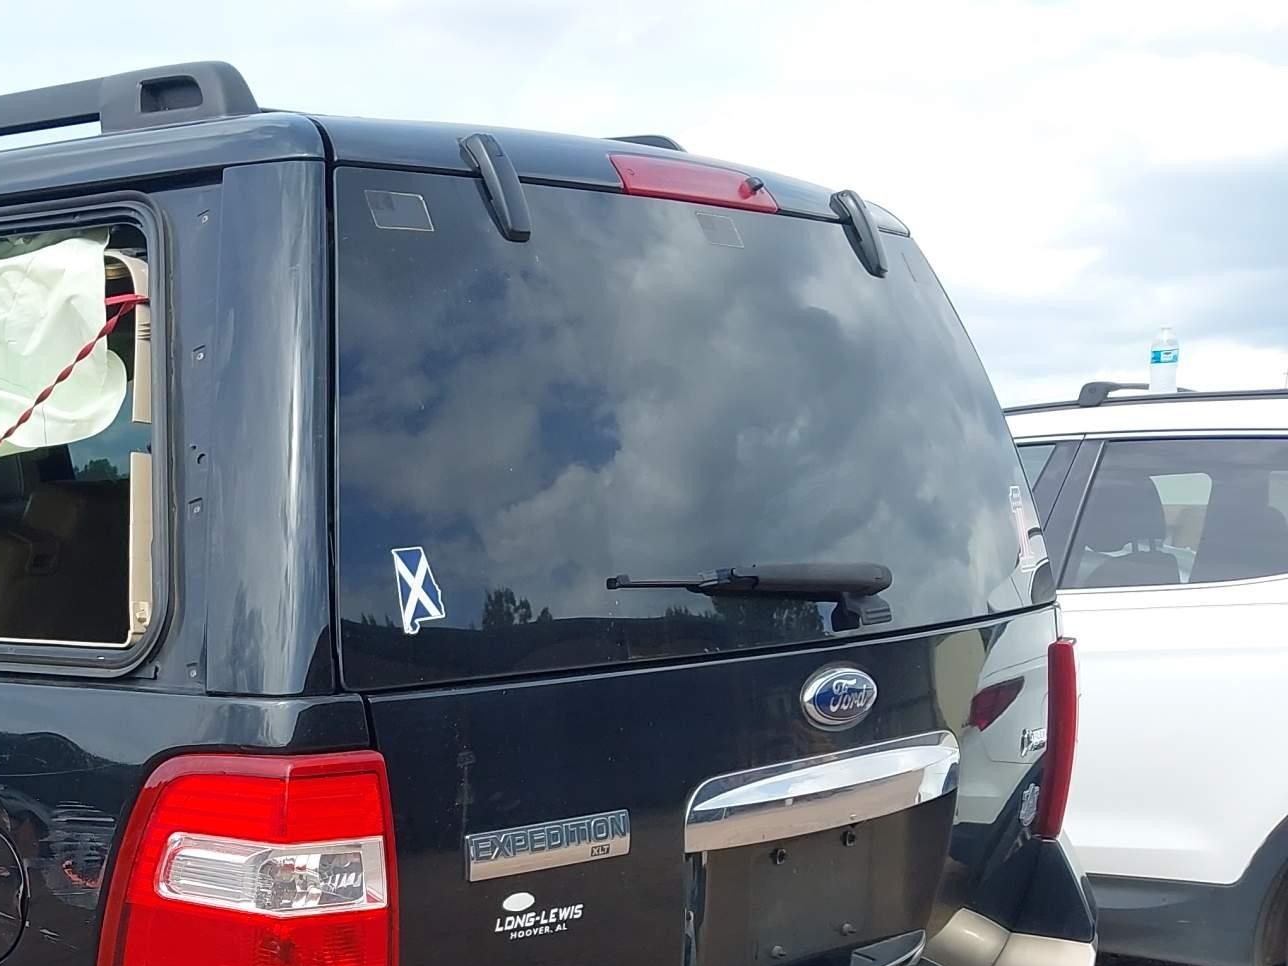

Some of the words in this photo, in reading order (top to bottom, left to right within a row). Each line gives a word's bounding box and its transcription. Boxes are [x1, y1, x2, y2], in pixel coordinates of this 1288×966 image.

[830, 679, 867, 712] Ford
[471, 813, 626, 862] EXPEDITION
[591, 845, 610, 856] XLT
[494, 904, 585, 932] LONG-LEWIS
[555, 923, 568, 932] AL
